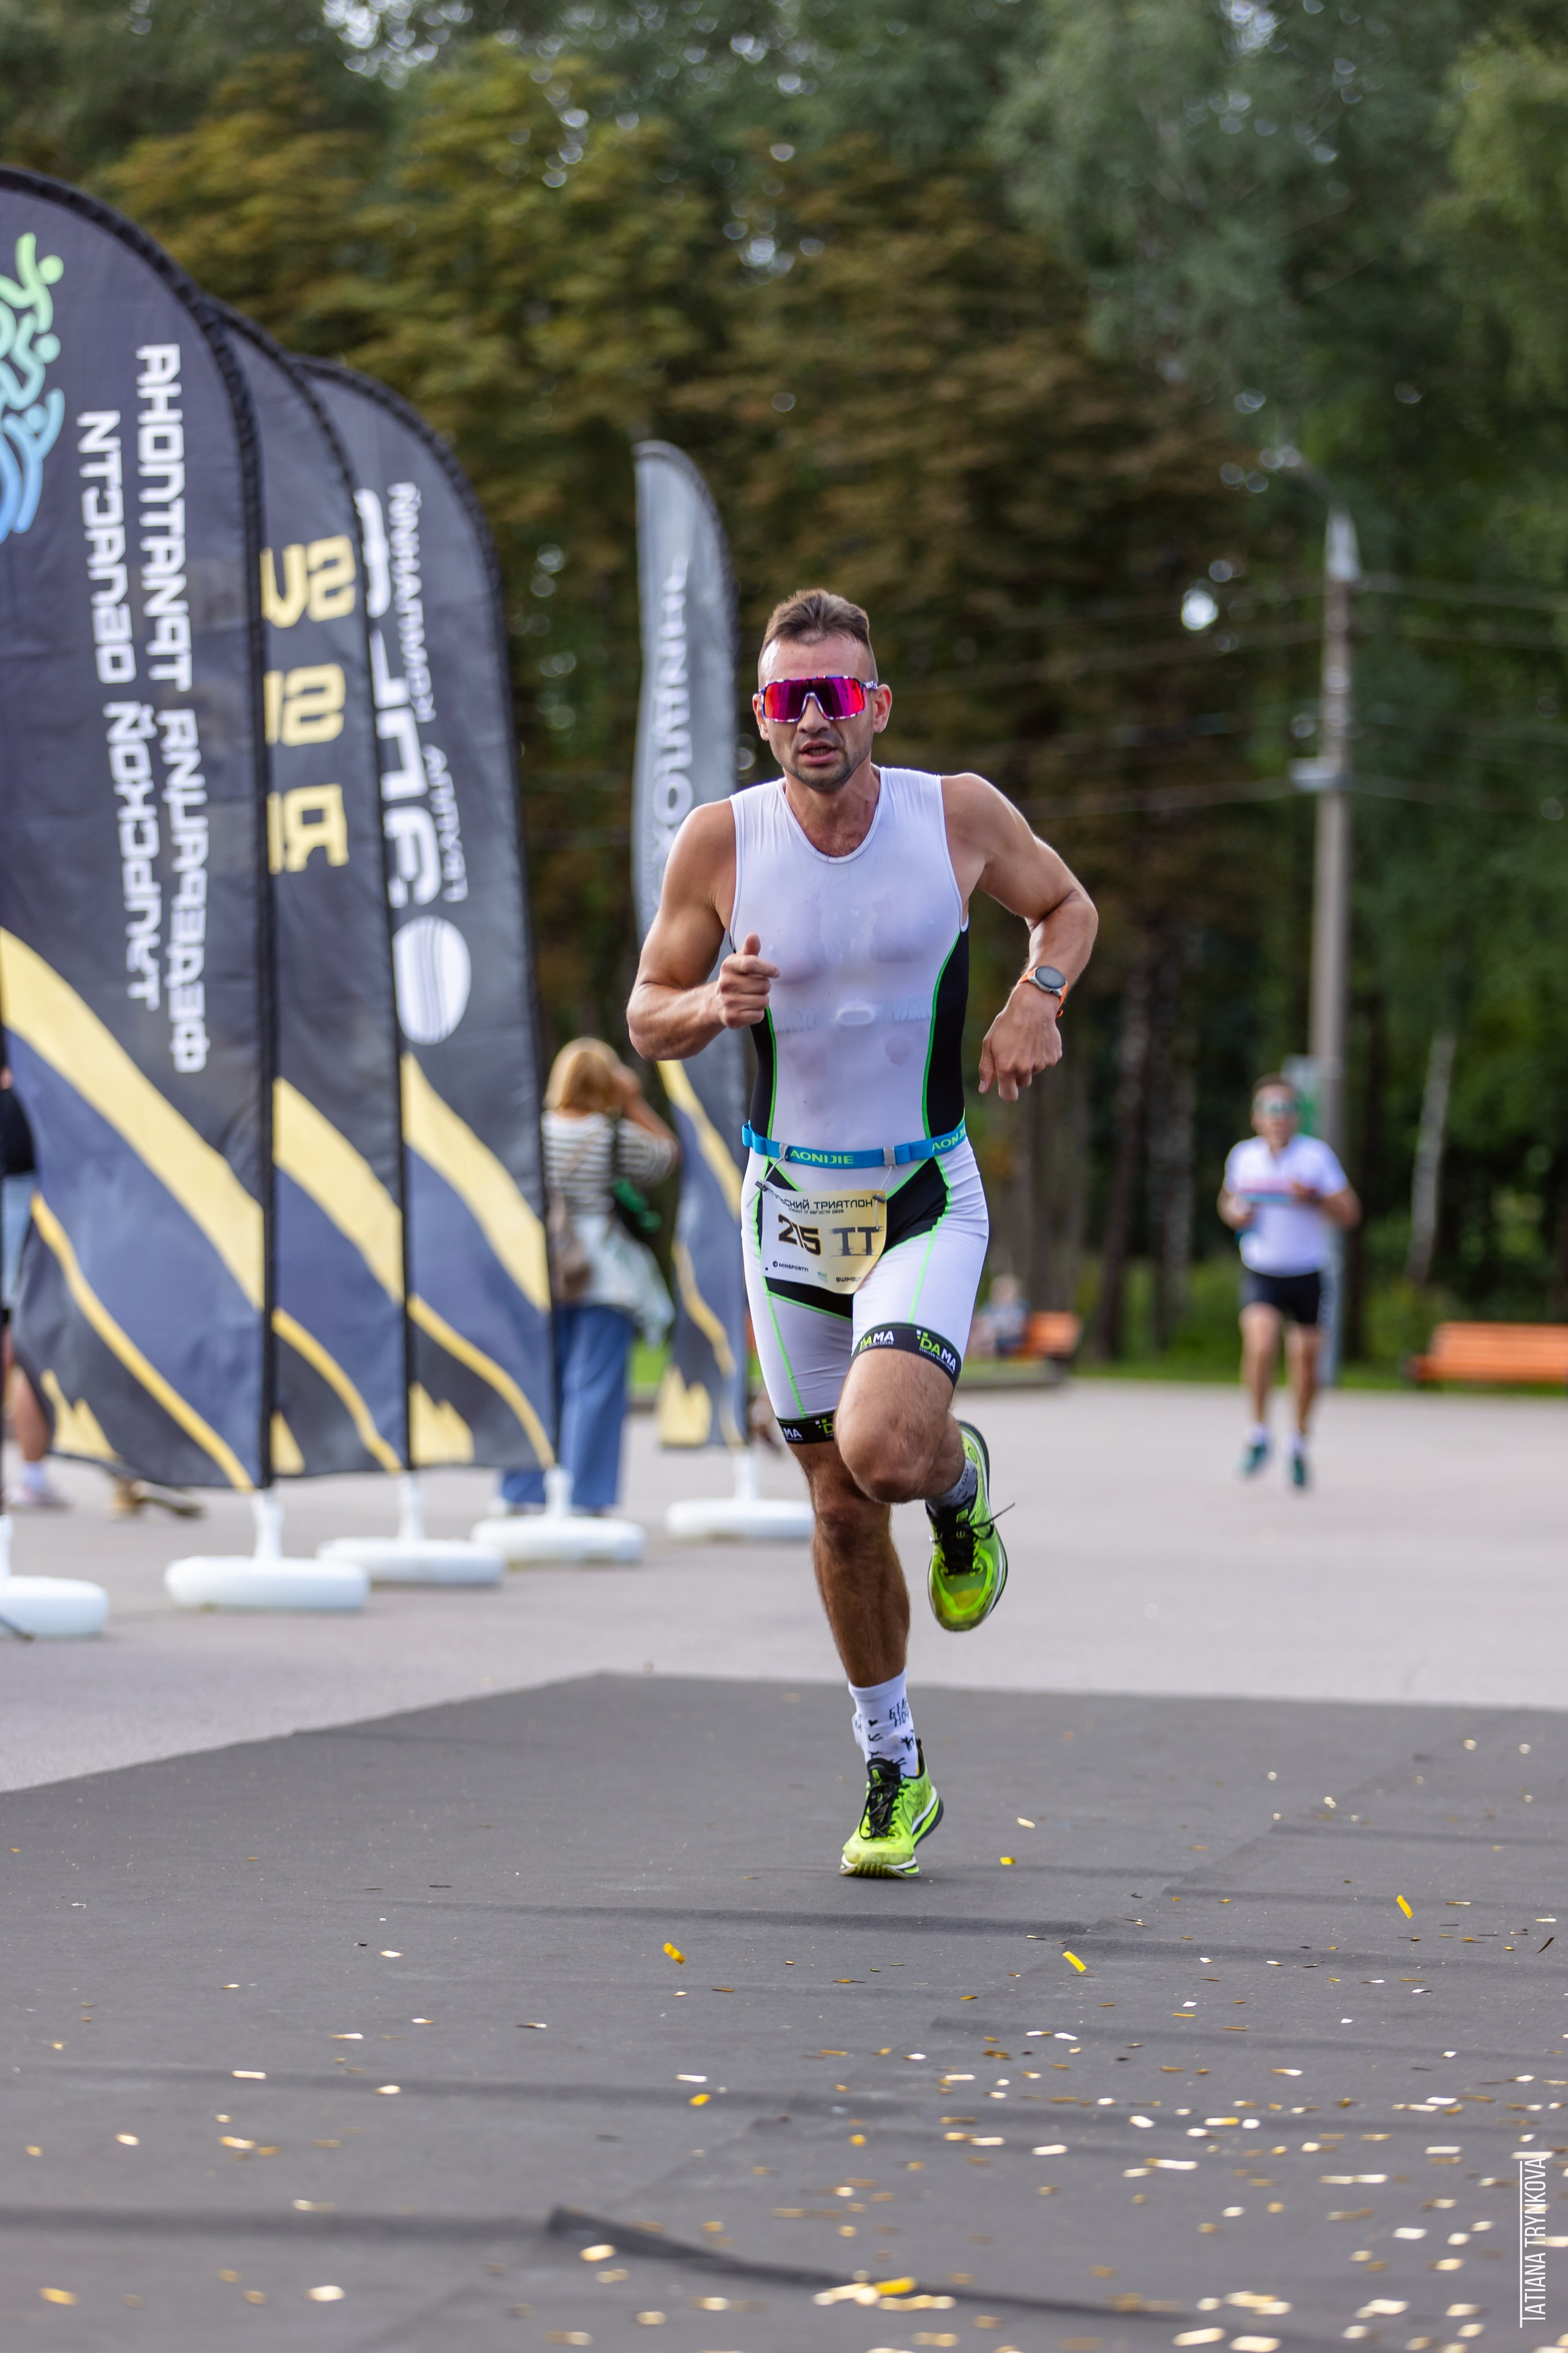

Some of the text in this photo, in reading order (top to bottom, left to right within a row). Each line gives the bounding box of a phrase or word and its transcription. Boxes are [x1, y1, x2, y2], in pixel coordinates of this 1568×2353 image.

[790, 1149, 854, 1165] AONIJIE
[813, 1199, 873, 1210] ТРИАТЛОН
[919, 1333, 956, 1372] DAMA
